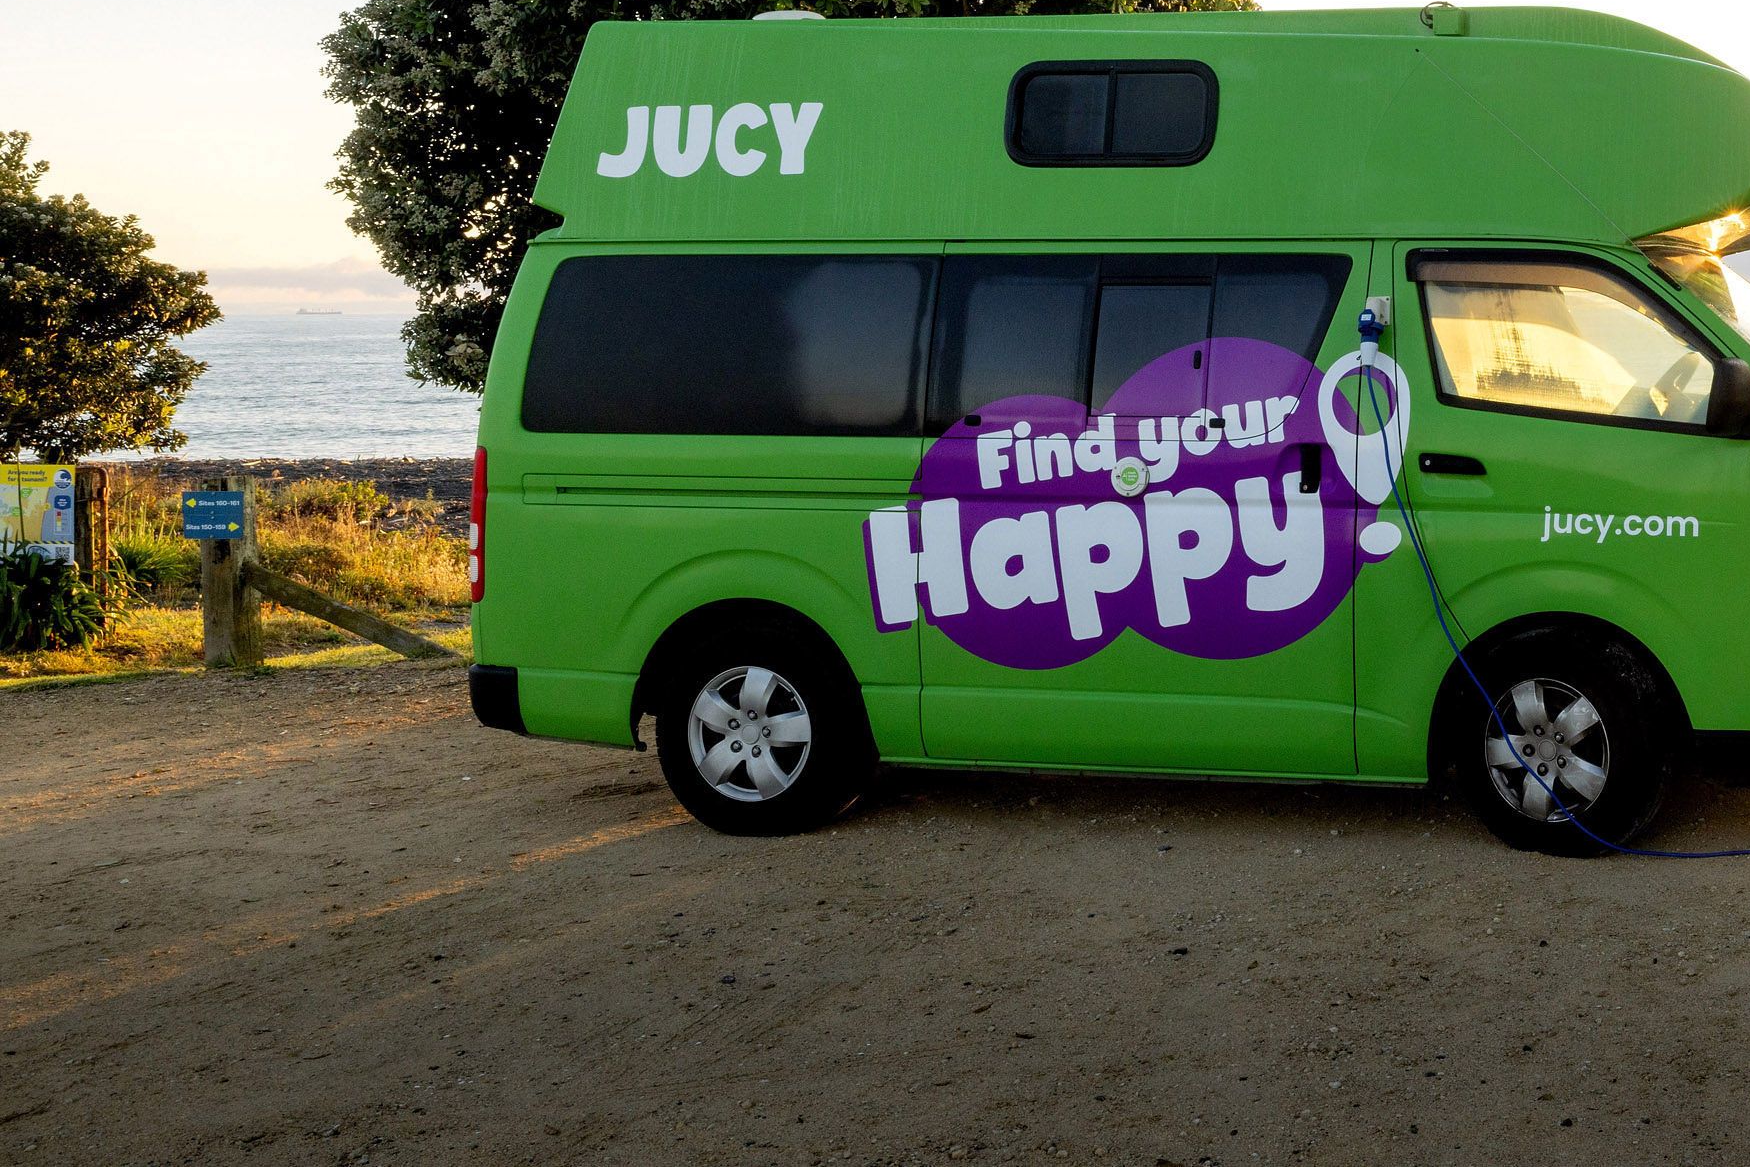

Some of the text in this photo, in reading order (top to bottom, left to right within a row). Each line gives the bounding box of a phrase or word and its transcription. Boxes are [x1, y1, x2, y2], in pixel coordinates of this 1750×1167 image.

[597, 102, 824, 178] JUCY
[977, 394, 1300, 490] Find your
[1540, 505, 1699, 544] jucy.com
